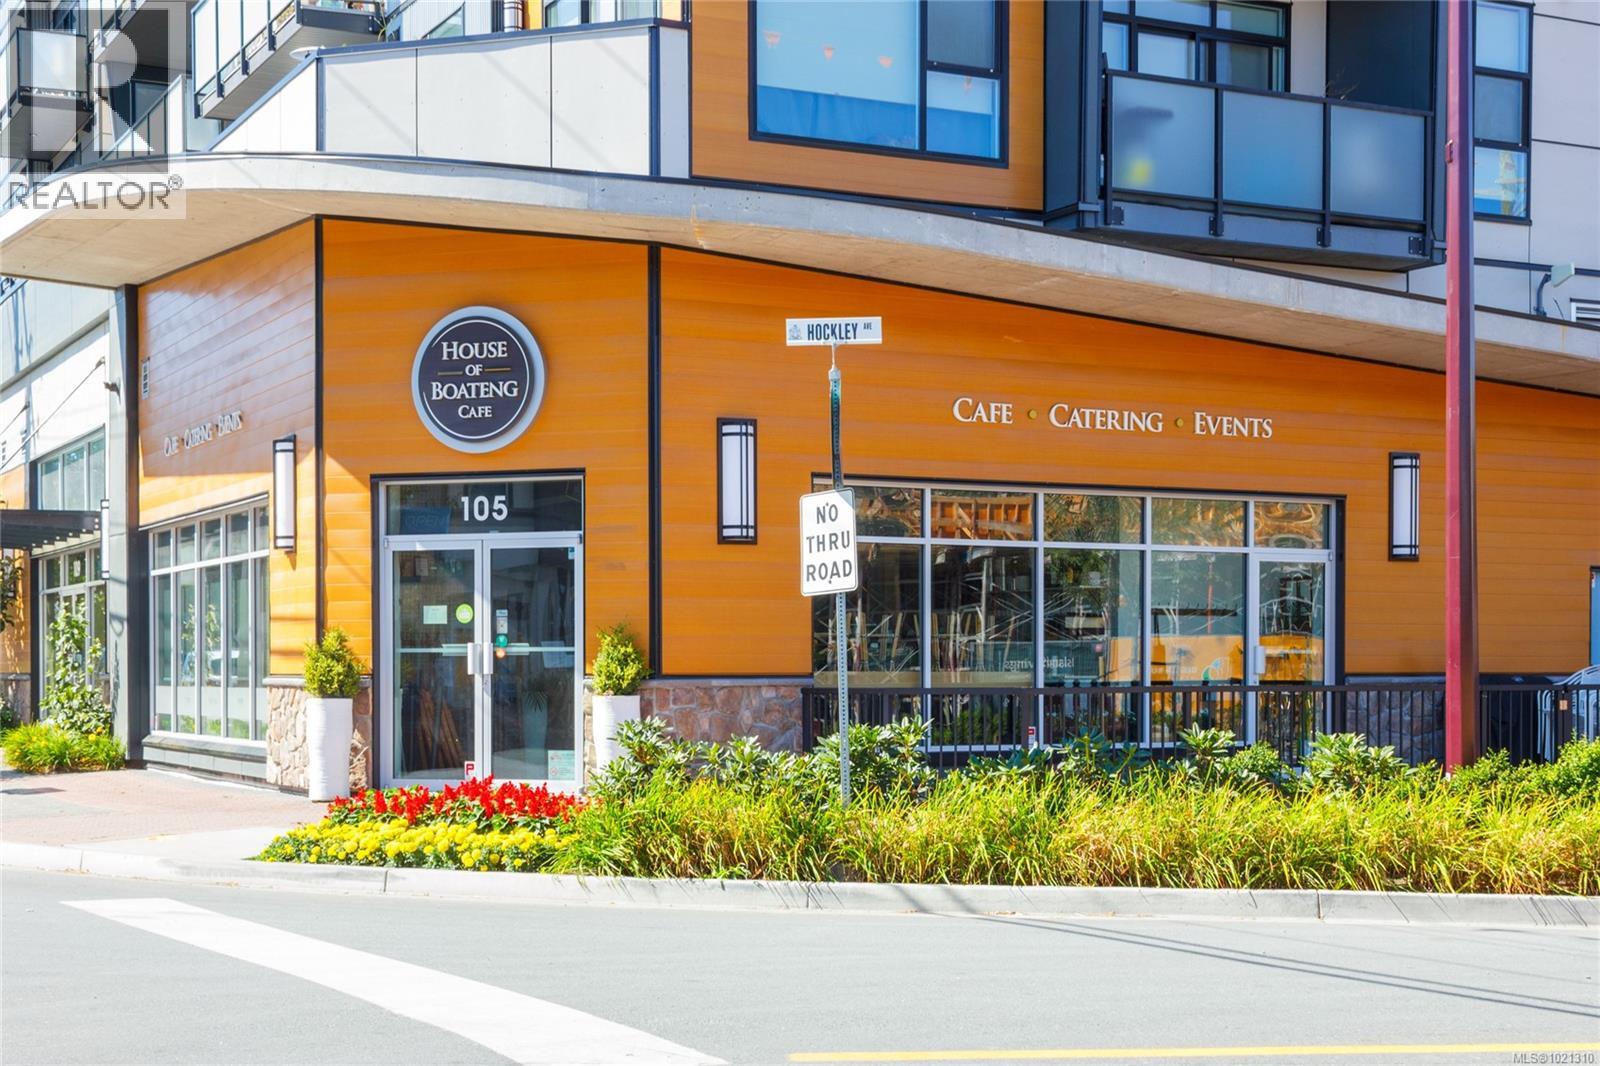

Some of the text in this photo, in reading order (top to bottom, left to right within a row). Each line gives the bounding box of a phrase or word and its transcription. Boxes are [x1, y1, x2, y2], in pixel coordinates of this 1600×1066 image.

[807, 322, 873, 341] HOCKLEY AVE
[441, 341, 508, 360] HOUSE
[465, 364, 483, 376] OF
[431, 380, 519, 400] BOATENG
[458, 404, 493, 419] CAFE
[952, 397, 1273, 438] CAFE CATERING EVENTS
[461, 495, 509, 522] 105
[816, 503, 839, 525] NO
[806, 530, 850, 554] THRU
[806, 559, 853, 582] ROAD
